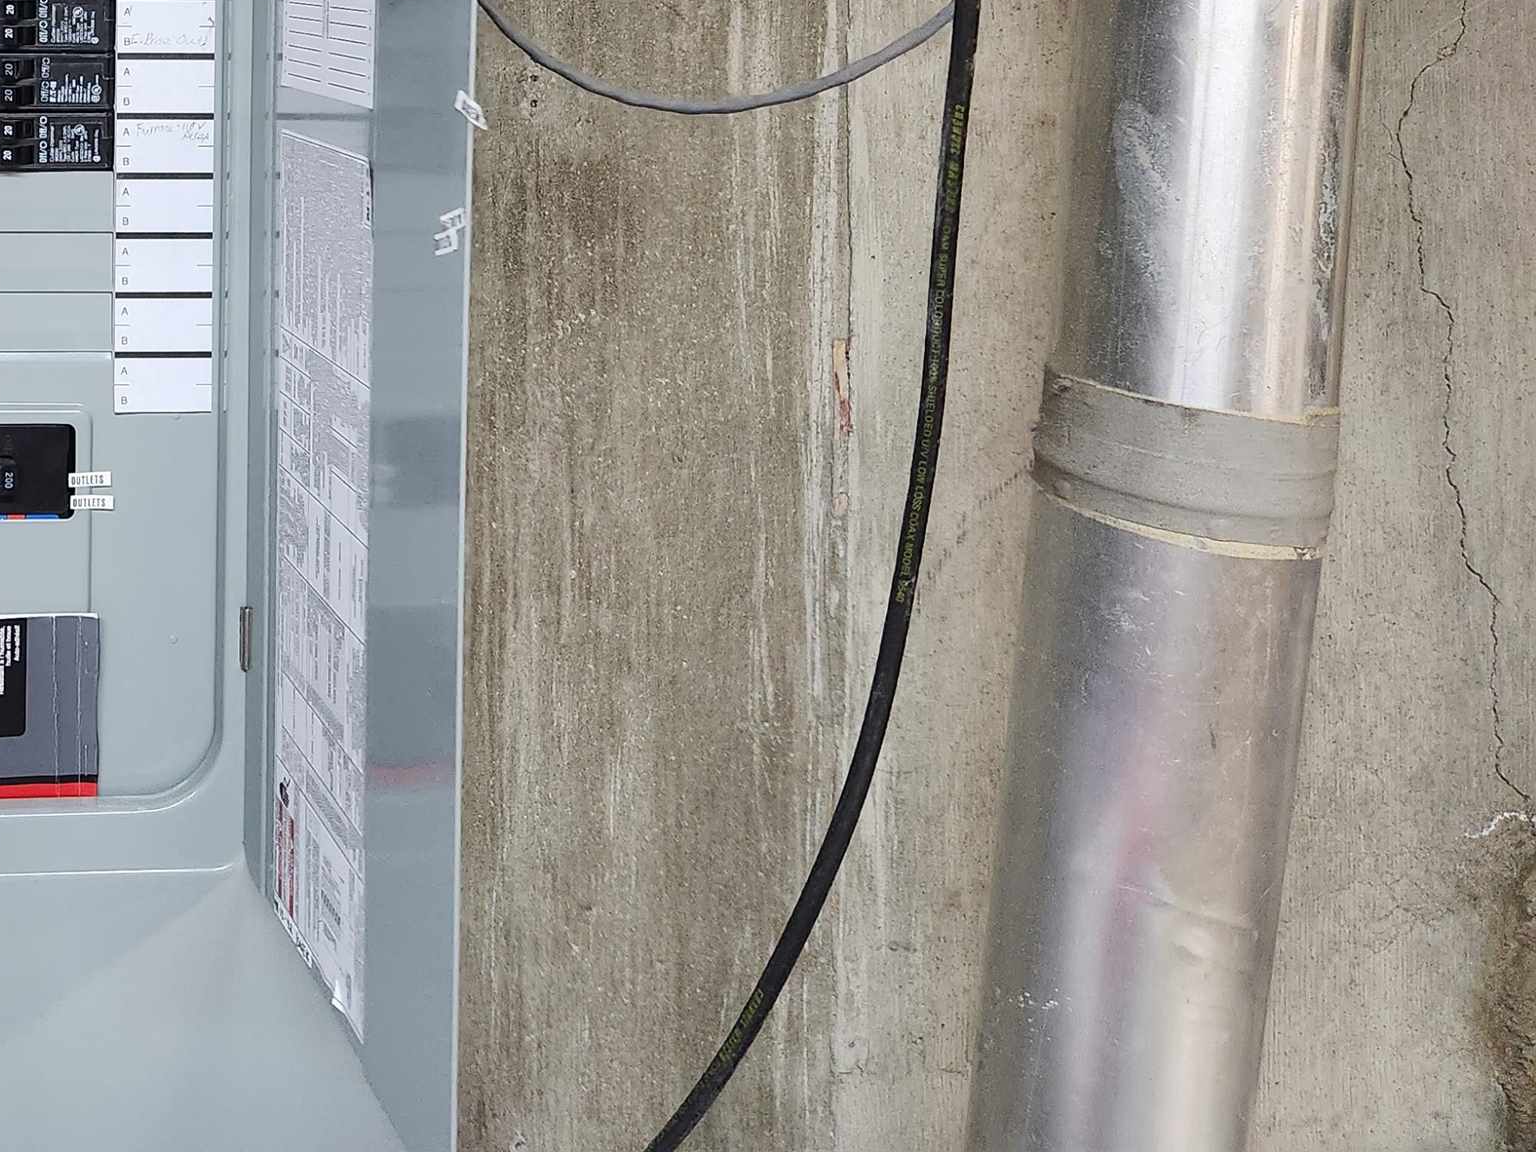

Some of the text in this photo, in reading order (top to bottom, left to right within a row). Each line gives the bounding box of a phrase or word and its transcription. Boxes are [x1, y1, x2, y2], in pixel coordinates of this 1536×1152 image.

[5, 64, 13, 76] 20
[4, 89, 13, 101] 20
[935, 254, 949, 286] SUPER
[923, 385, 937, 437] SHIELDED
[920, 440, 929, 458] U/V
[5, 472, 13, 489] 200
[71, 474, 104, 485] OUTLETS
[915, 461, 928, 484] LOW
[72, 498, 106, 508] OUTLETS
[912, 486, 924, 512] LOSS
[906, 513, 919, 540] COAX
[900, 542, 913, 577] MODEL
